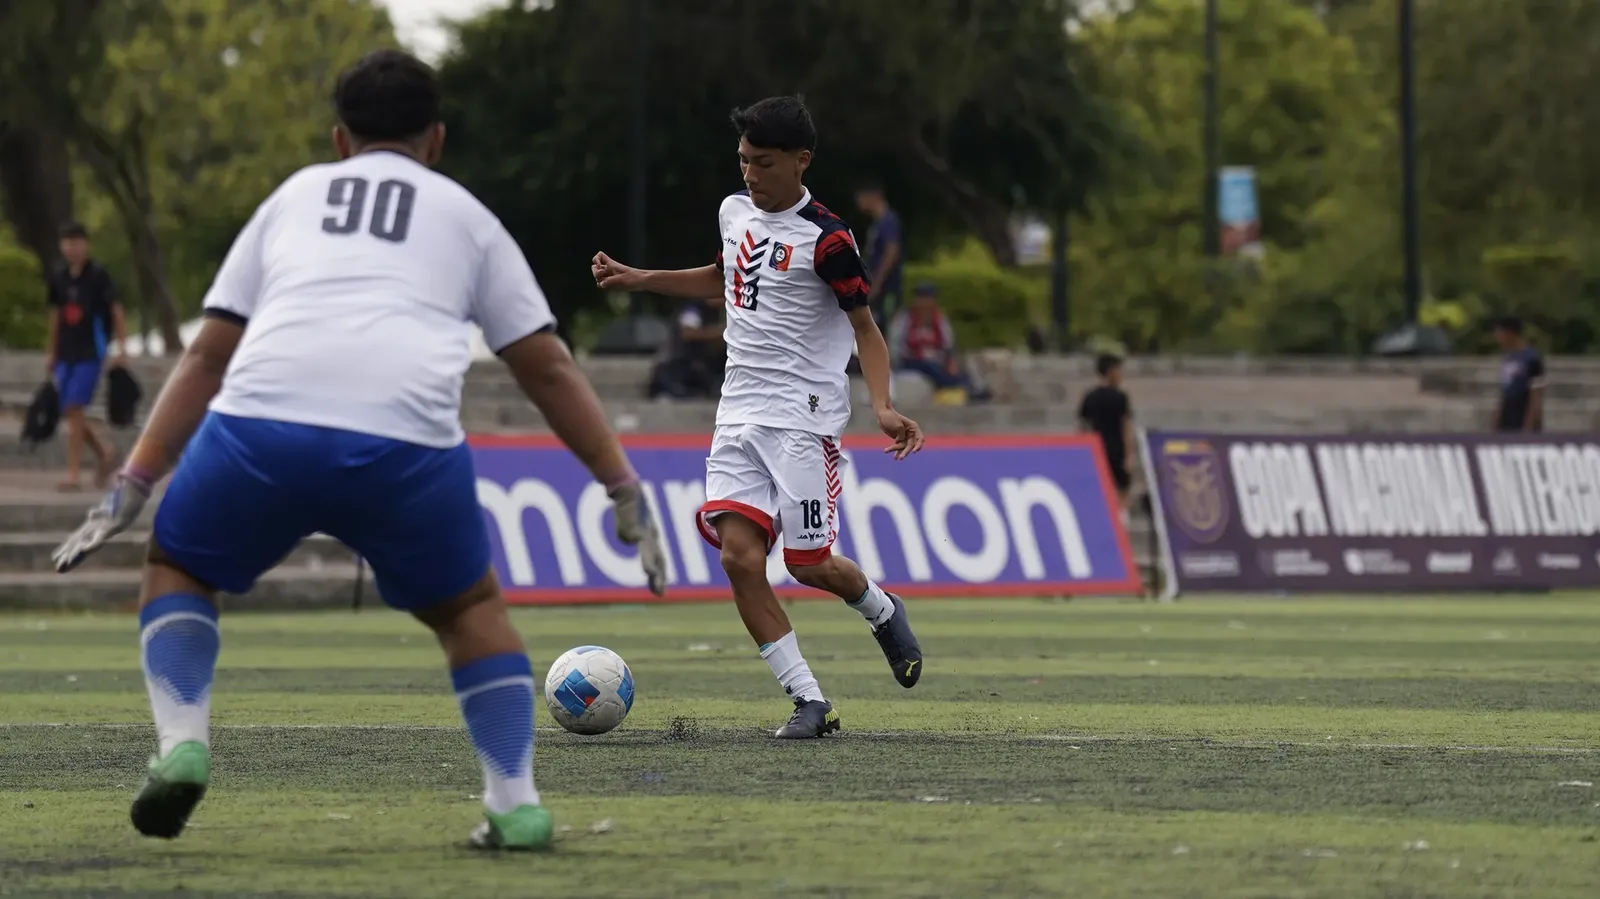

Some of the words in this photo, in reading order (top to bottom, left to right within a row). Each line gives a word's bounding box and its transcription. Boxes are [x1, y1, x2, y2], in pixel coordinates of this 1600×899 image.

[321, 177, 416, 243] 90
[799, 499, 823, 529] 18
[1229, 442, 1329, 538] COPA
[1315, 442, 1489, 537] NACIONAL
